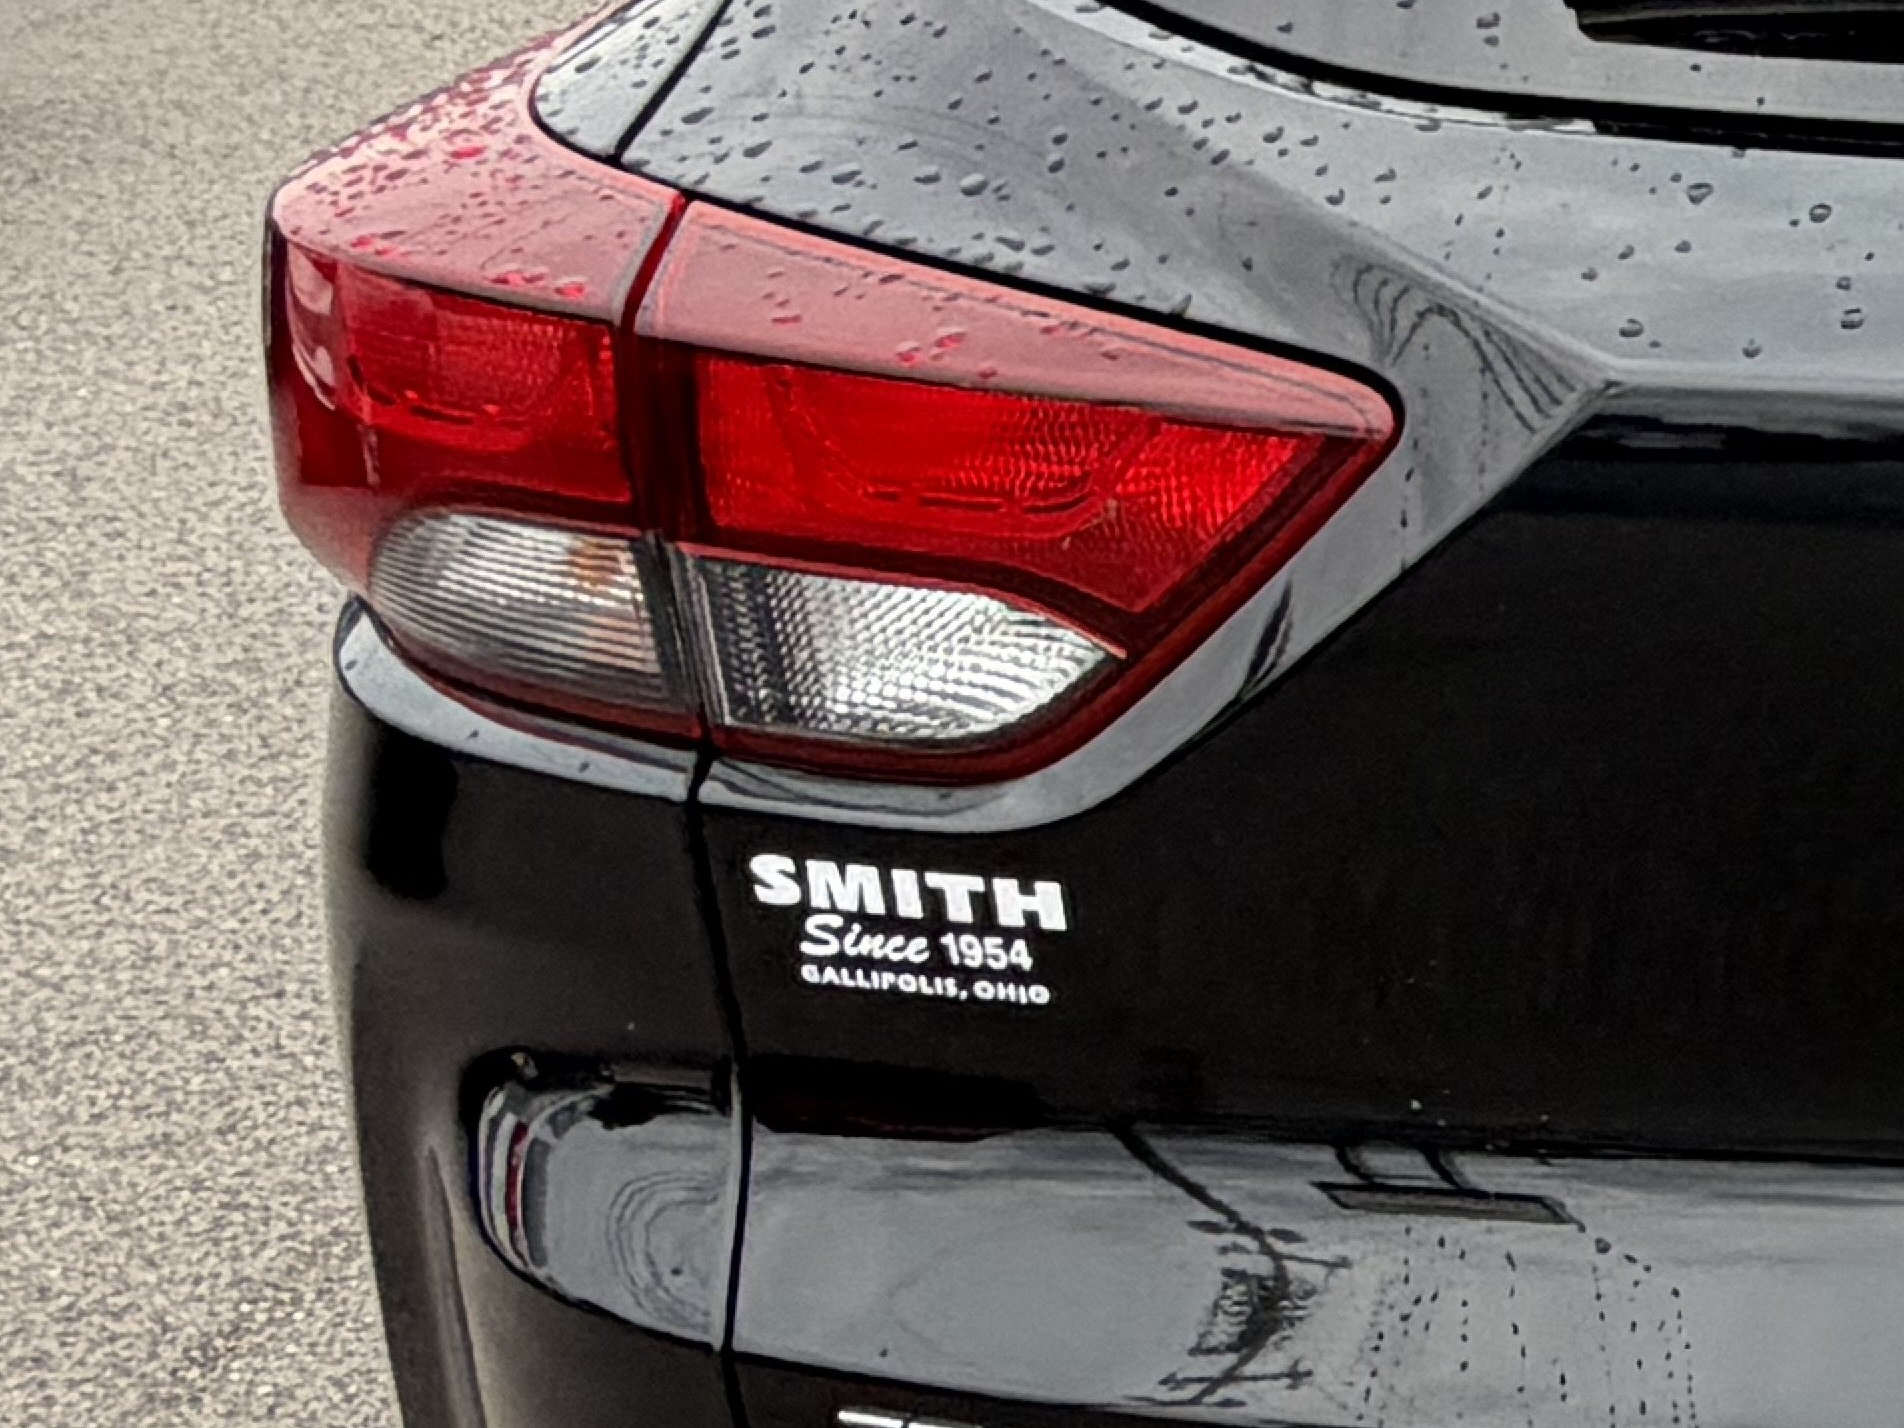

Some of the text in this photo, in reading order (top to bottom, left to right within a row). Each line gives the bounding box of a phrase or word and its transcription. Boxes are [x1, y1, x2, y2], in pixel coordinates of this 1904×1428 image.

[750, 854, 1067, 931] SMITH
[799, 913, 1033, 971] Since 1954
[972, 980, 1051, 1005] OHIO
